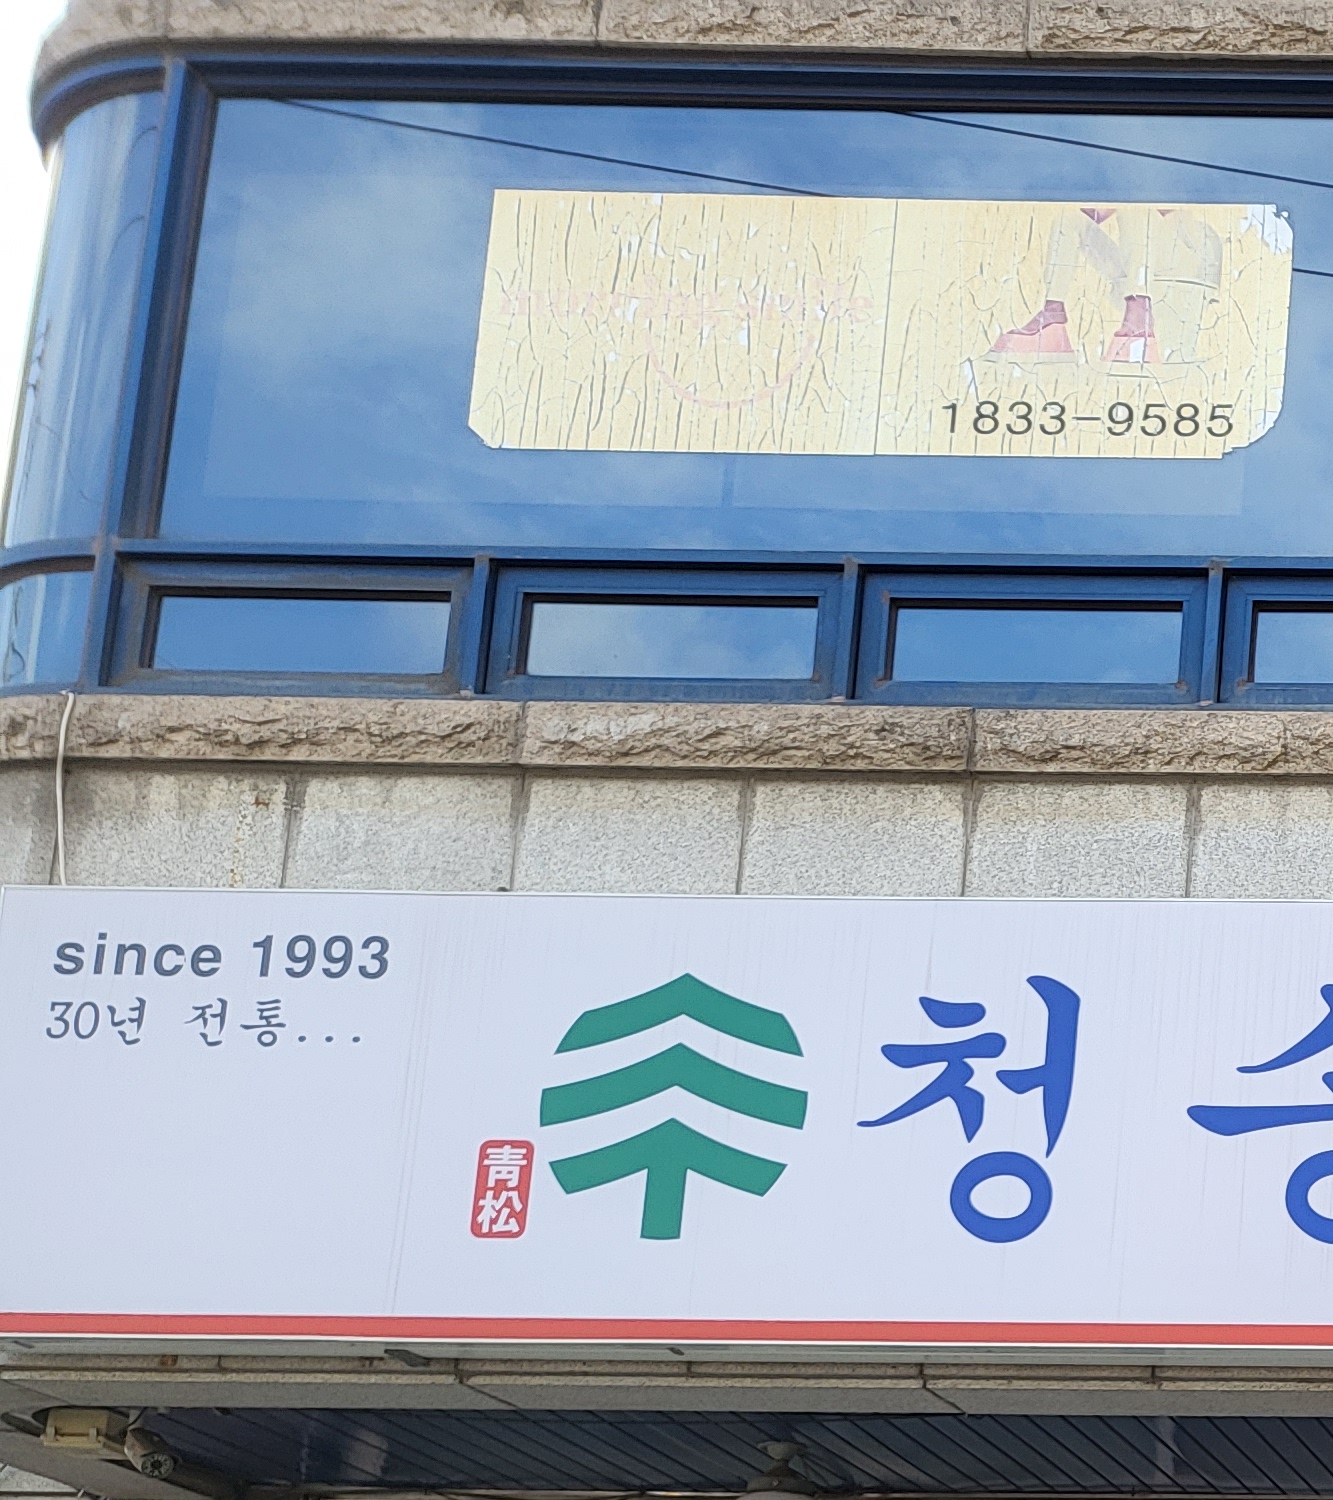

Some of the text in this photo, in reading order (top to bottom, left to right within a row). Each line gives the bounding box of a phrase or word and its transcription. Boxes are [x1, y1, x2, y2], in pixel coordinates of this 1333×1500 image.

[942, 401, 1235, 438] 1833-9585
[52, 932, 391, 979] since 1993
[45, 996, 363, 1048] 30년 전통...
[474, 1142, 530, 1236] 青松
